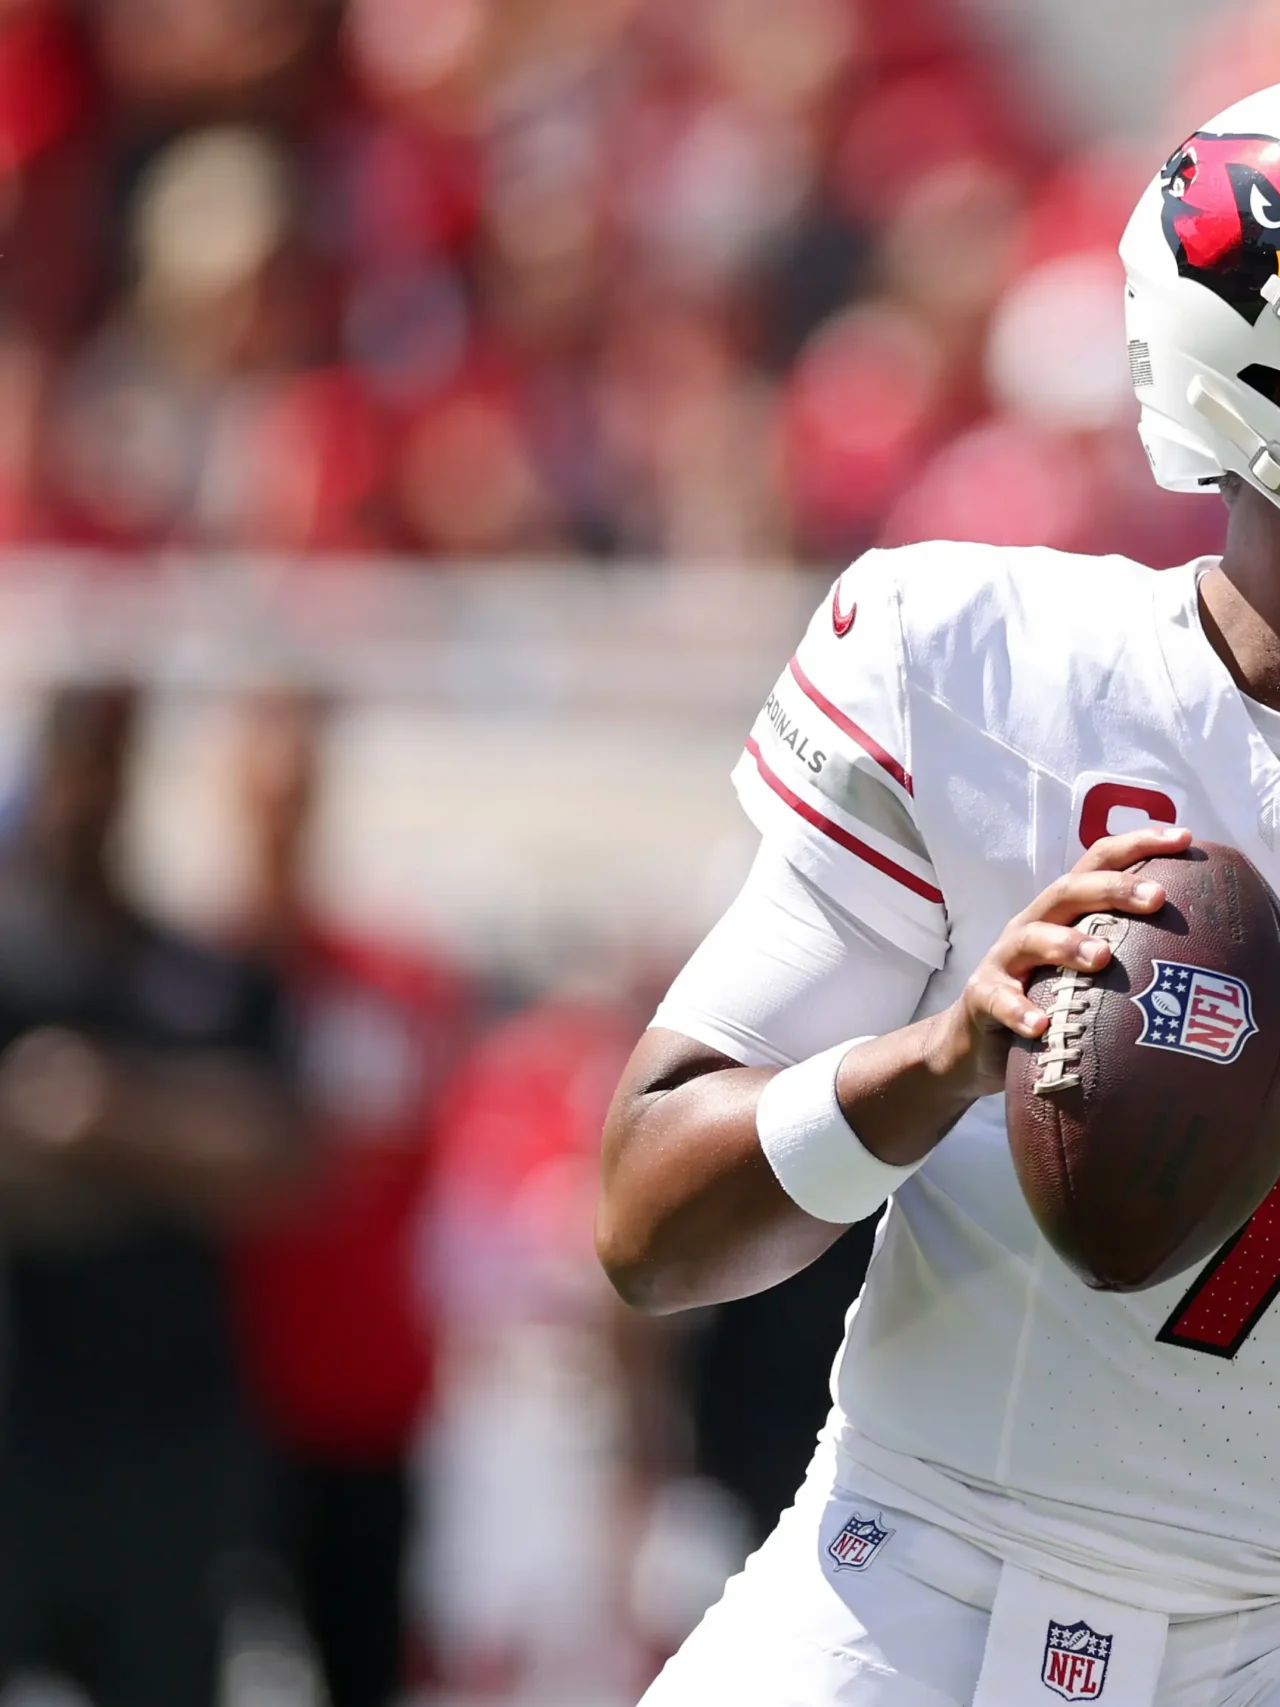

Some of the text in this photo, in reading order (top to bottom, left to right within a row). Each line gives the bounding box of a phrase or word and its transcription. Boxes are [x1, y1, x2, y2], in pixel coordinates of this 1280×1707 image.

[1185, 984, 1244, 1054] NFL
[832, 1532, 870, 1564] NFL
[1046, 1650, 1098, 1695] NFL
